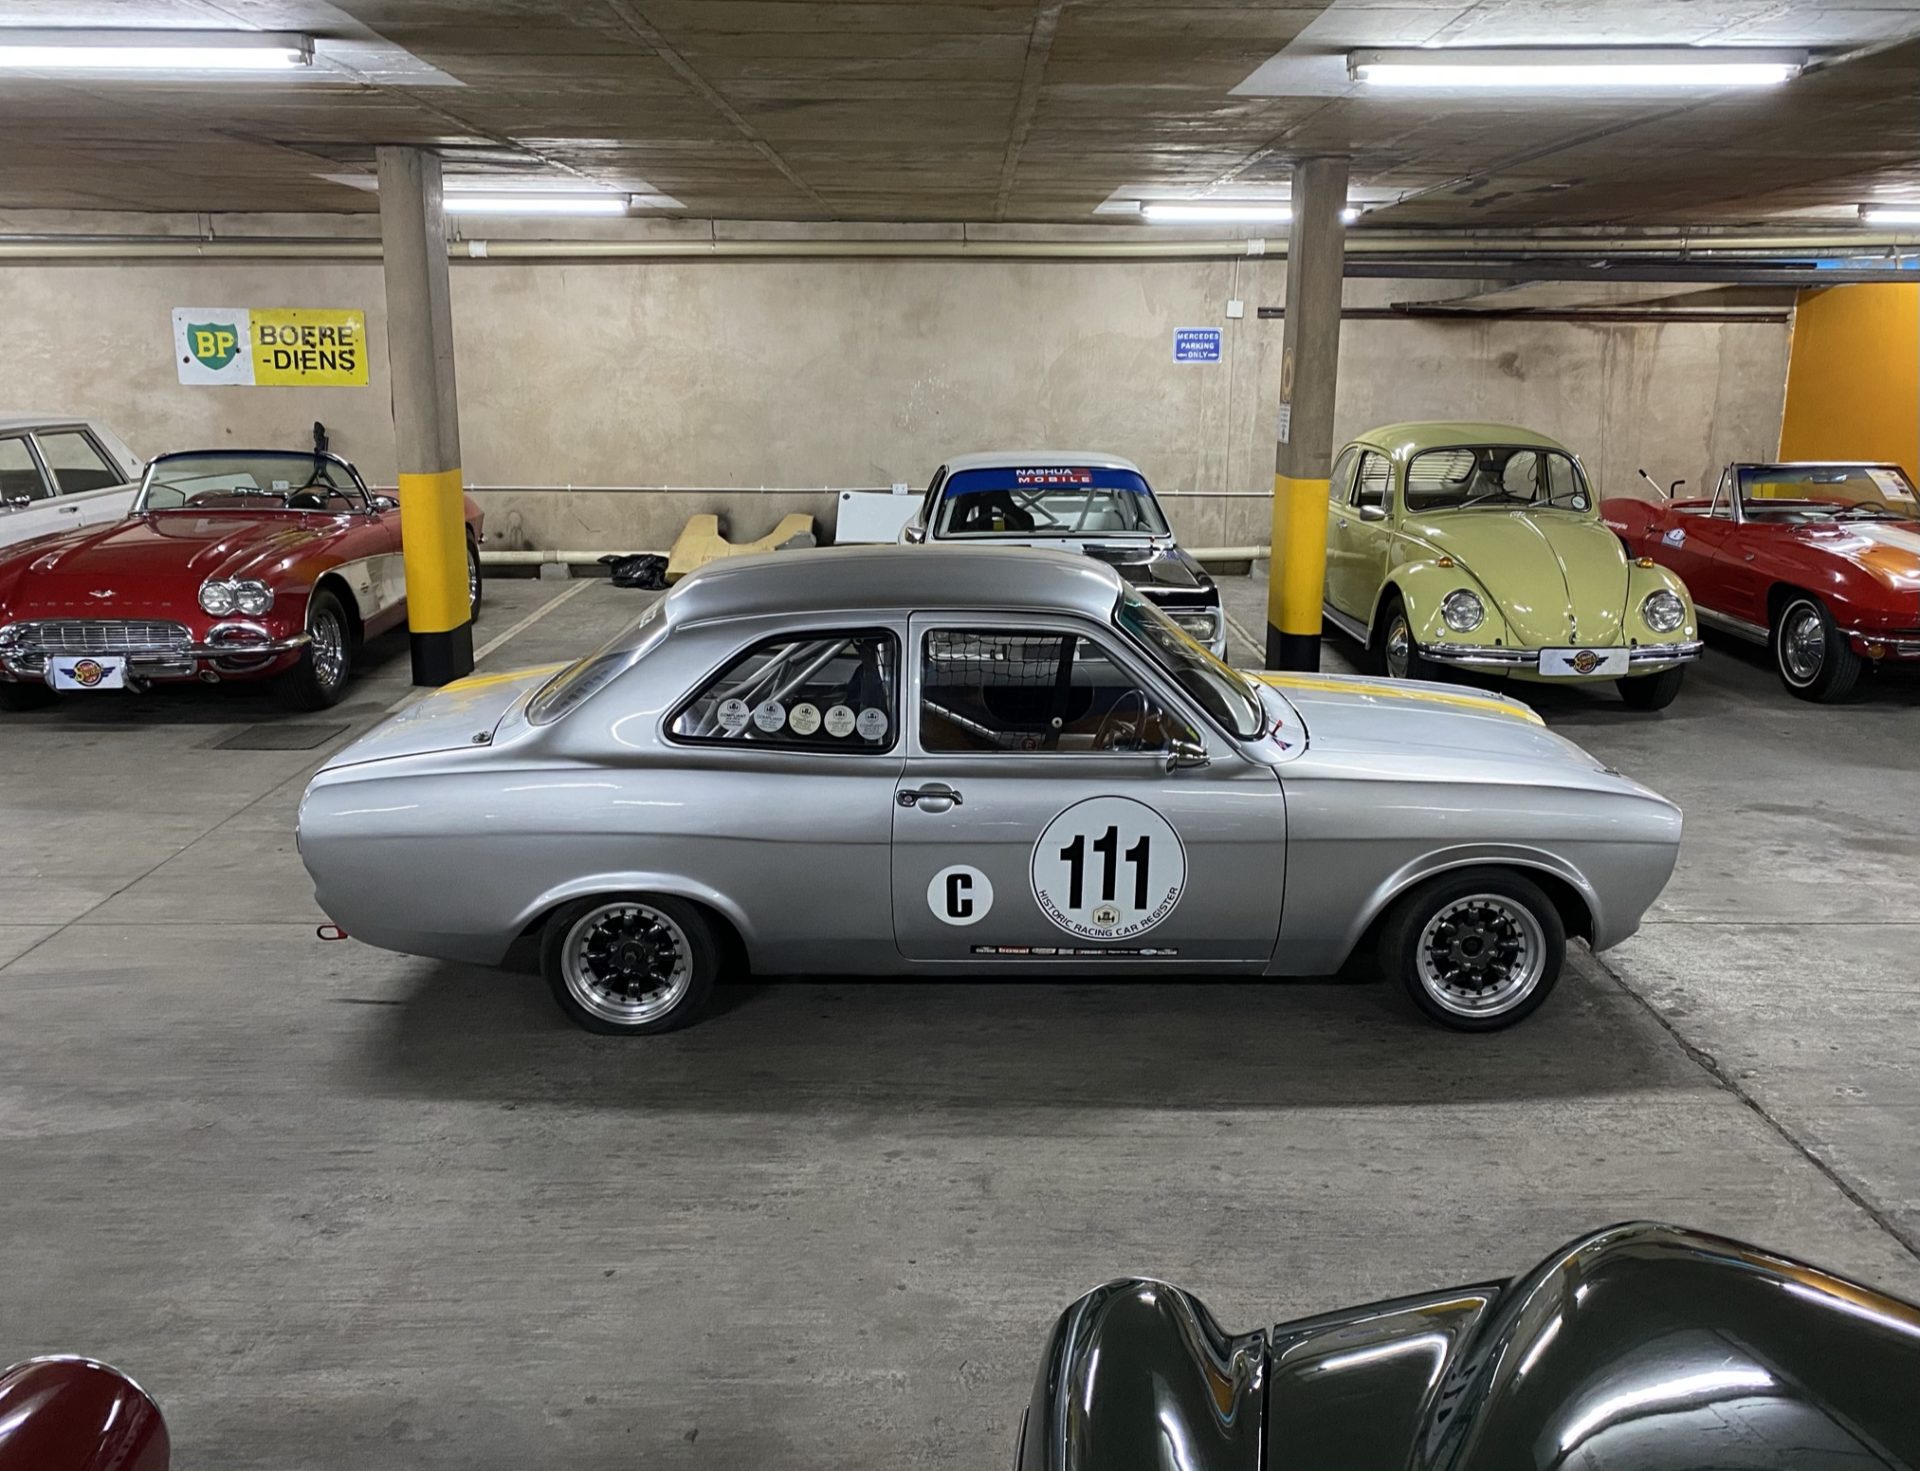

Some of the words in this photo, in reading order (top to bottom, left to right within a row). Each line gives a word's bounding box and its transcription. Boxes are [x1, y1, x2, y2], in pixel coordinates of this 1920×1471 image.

[195, 331, 235, 358] BP
[260, 325, 354, 346] BOERE
[1181, 342, 1214, 350] PARKING
[263, 350, 355, 370] -DIENS
[1060, 826, 1150, 910] 111
[946, 873, 973, 918] C
[1039, 889, 1074, 927] HISTORIC
[1074, 923, 1112, 937] RACING
[1116, 924, 1139, 936] CAR
[1140, 886, 1178, 927] REGISTER
